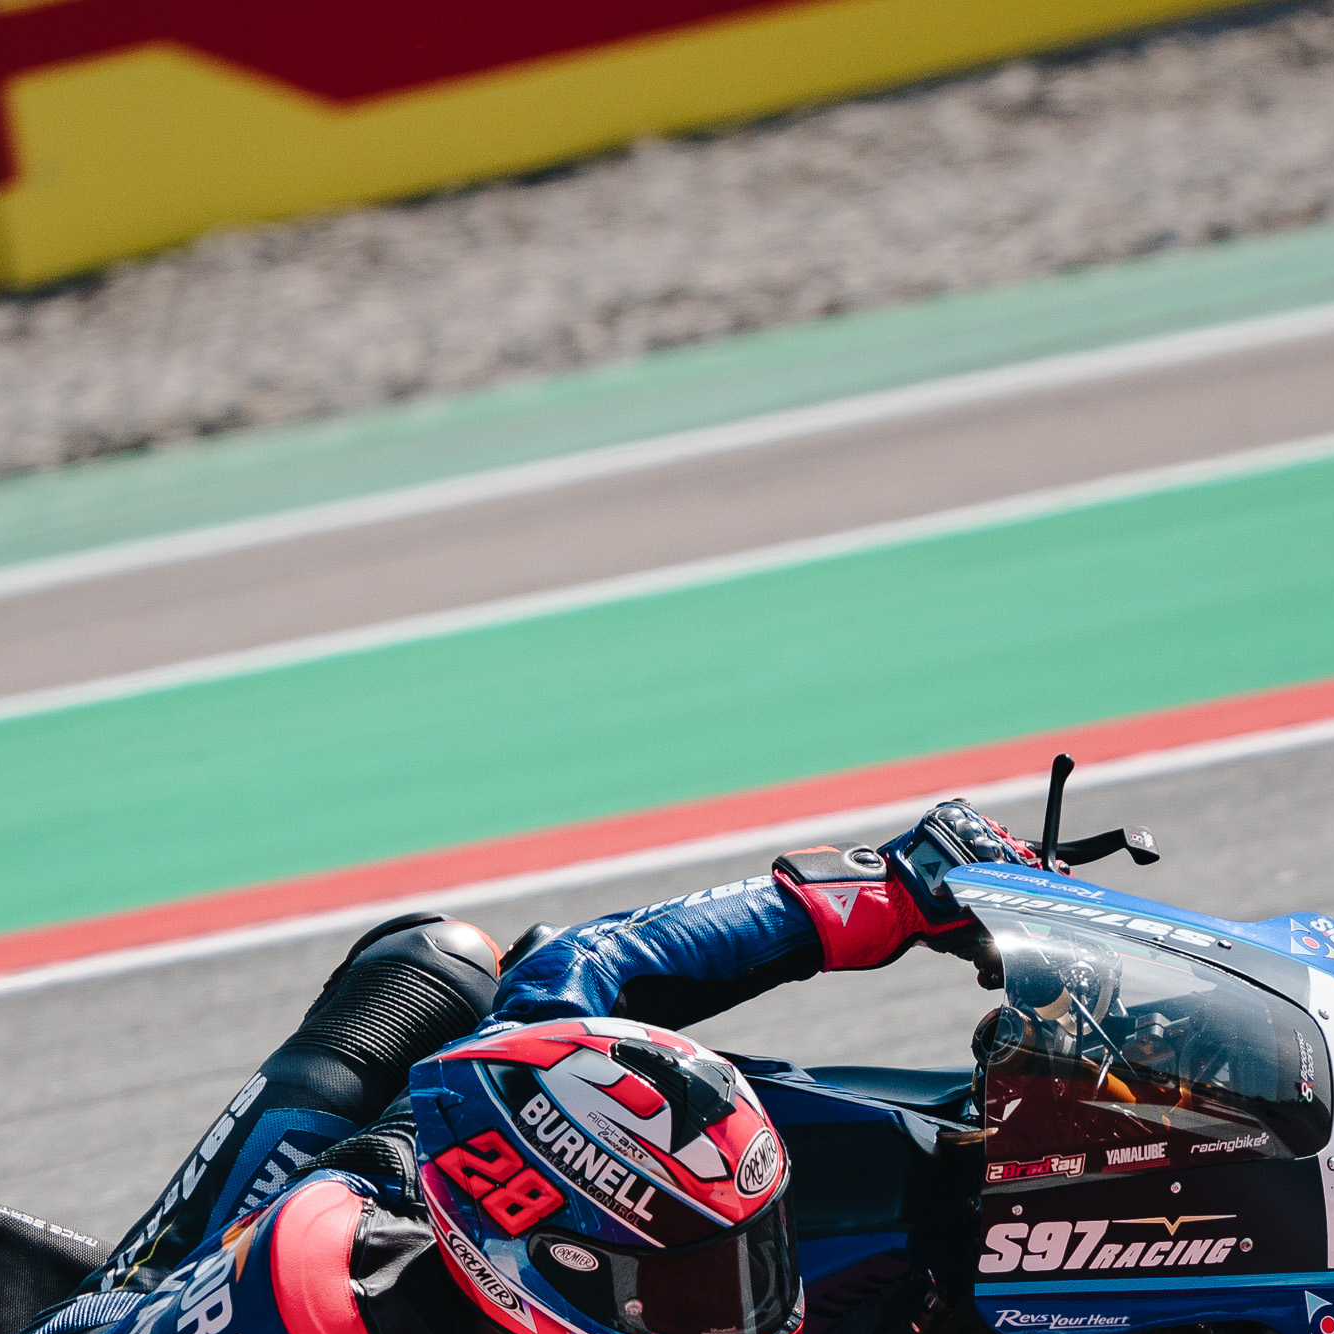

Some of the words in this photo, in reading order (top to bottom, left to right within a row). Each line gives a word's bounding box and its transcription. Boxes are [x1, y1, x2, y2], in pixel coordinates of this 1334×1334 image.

[519, 1092, 656, 1222] BURNELL
[1106, 1143, 1167, 1165] YAMALUBE
[1190, 1135, 1262, 1154] racingbike
[433, 1127, 565, 1237] 28
[586, 1184, 639, 1227] CONTROL
[556, 1247, 592, 1268] PREMIER
[1088, 1236, 1237, 1270] RACING
[453, 1243, 510, 1303] PREMIER
[994, 1309, 1049, 1328] Revs
[1086, 1315, 1130, 1328] Heart
